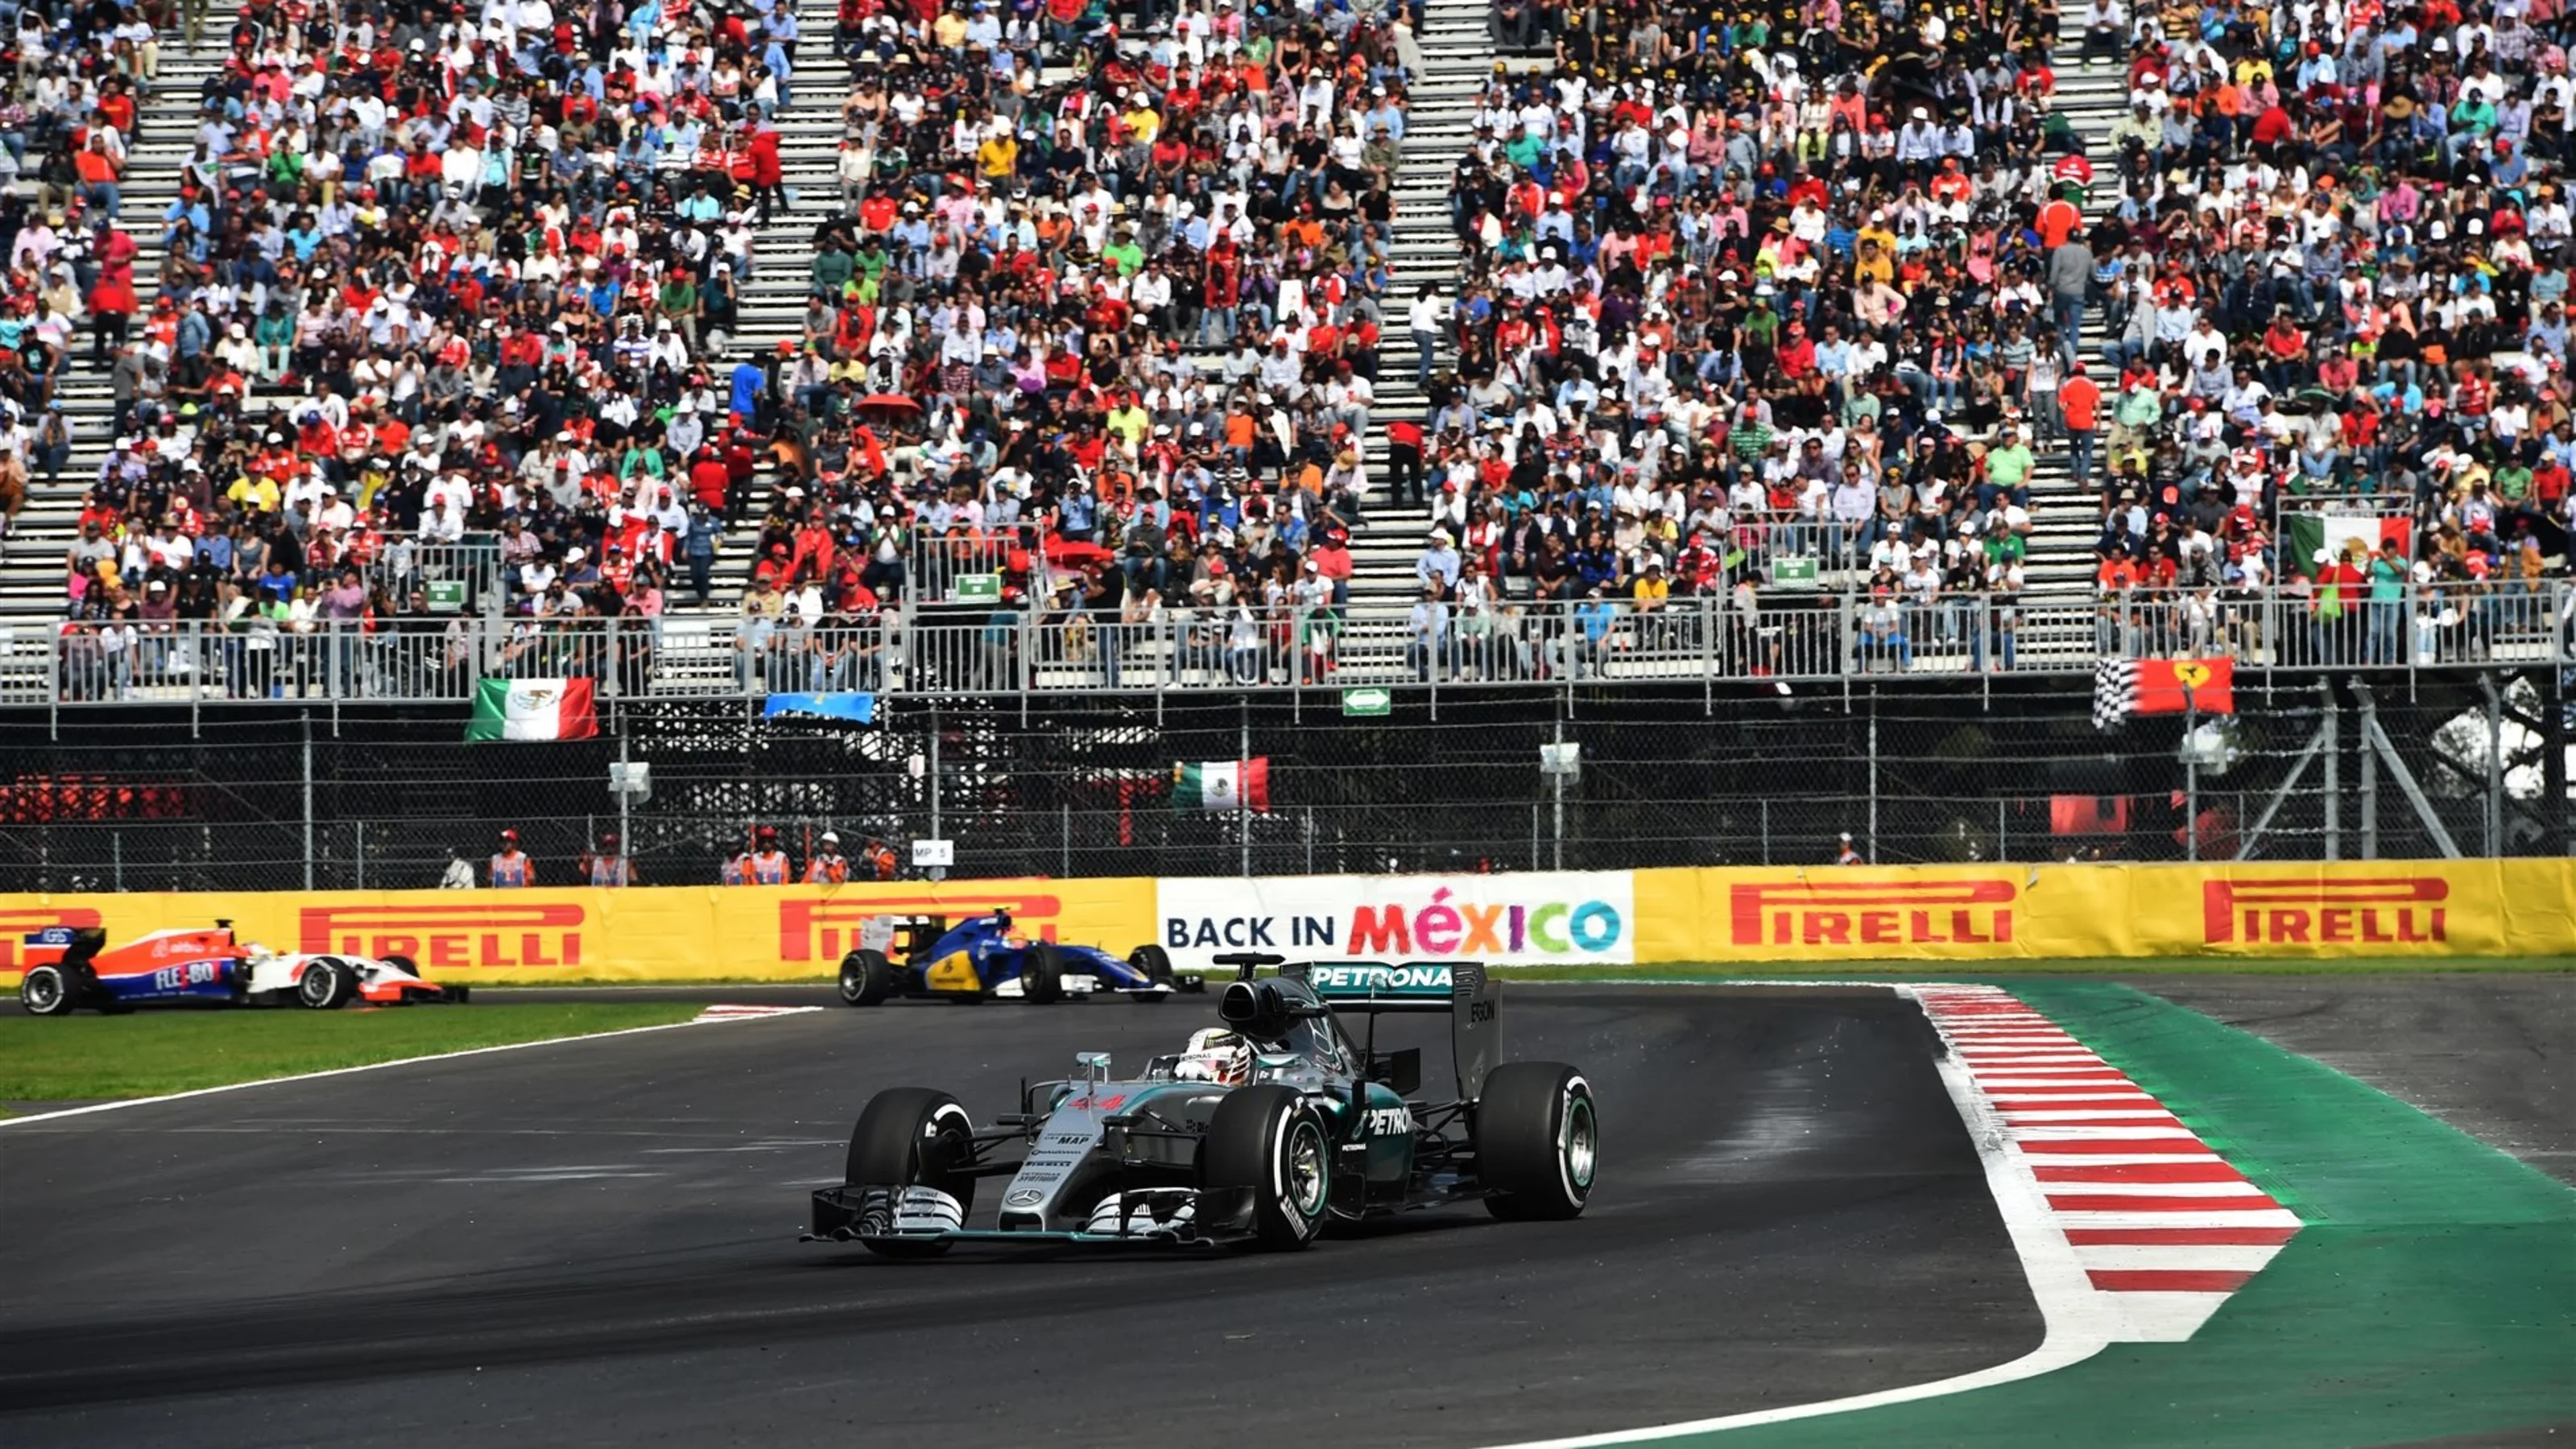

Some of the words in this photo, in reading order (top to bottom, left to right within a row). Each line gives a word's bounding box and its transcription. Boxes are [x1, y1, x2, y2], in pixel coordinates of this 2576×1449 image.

[915, 848, 932, 858] MP
[1168, 917, 1276, 948] BACK
[1292, 916, 1333, 946] IN
[1731, 879, 2016, 945] PIRELLI
[2203, 877, 2449, 943] PIRELLI
[300, 904, 585, 966] PIRELLI
[1312, 968, 1453, 986] PETRONA
